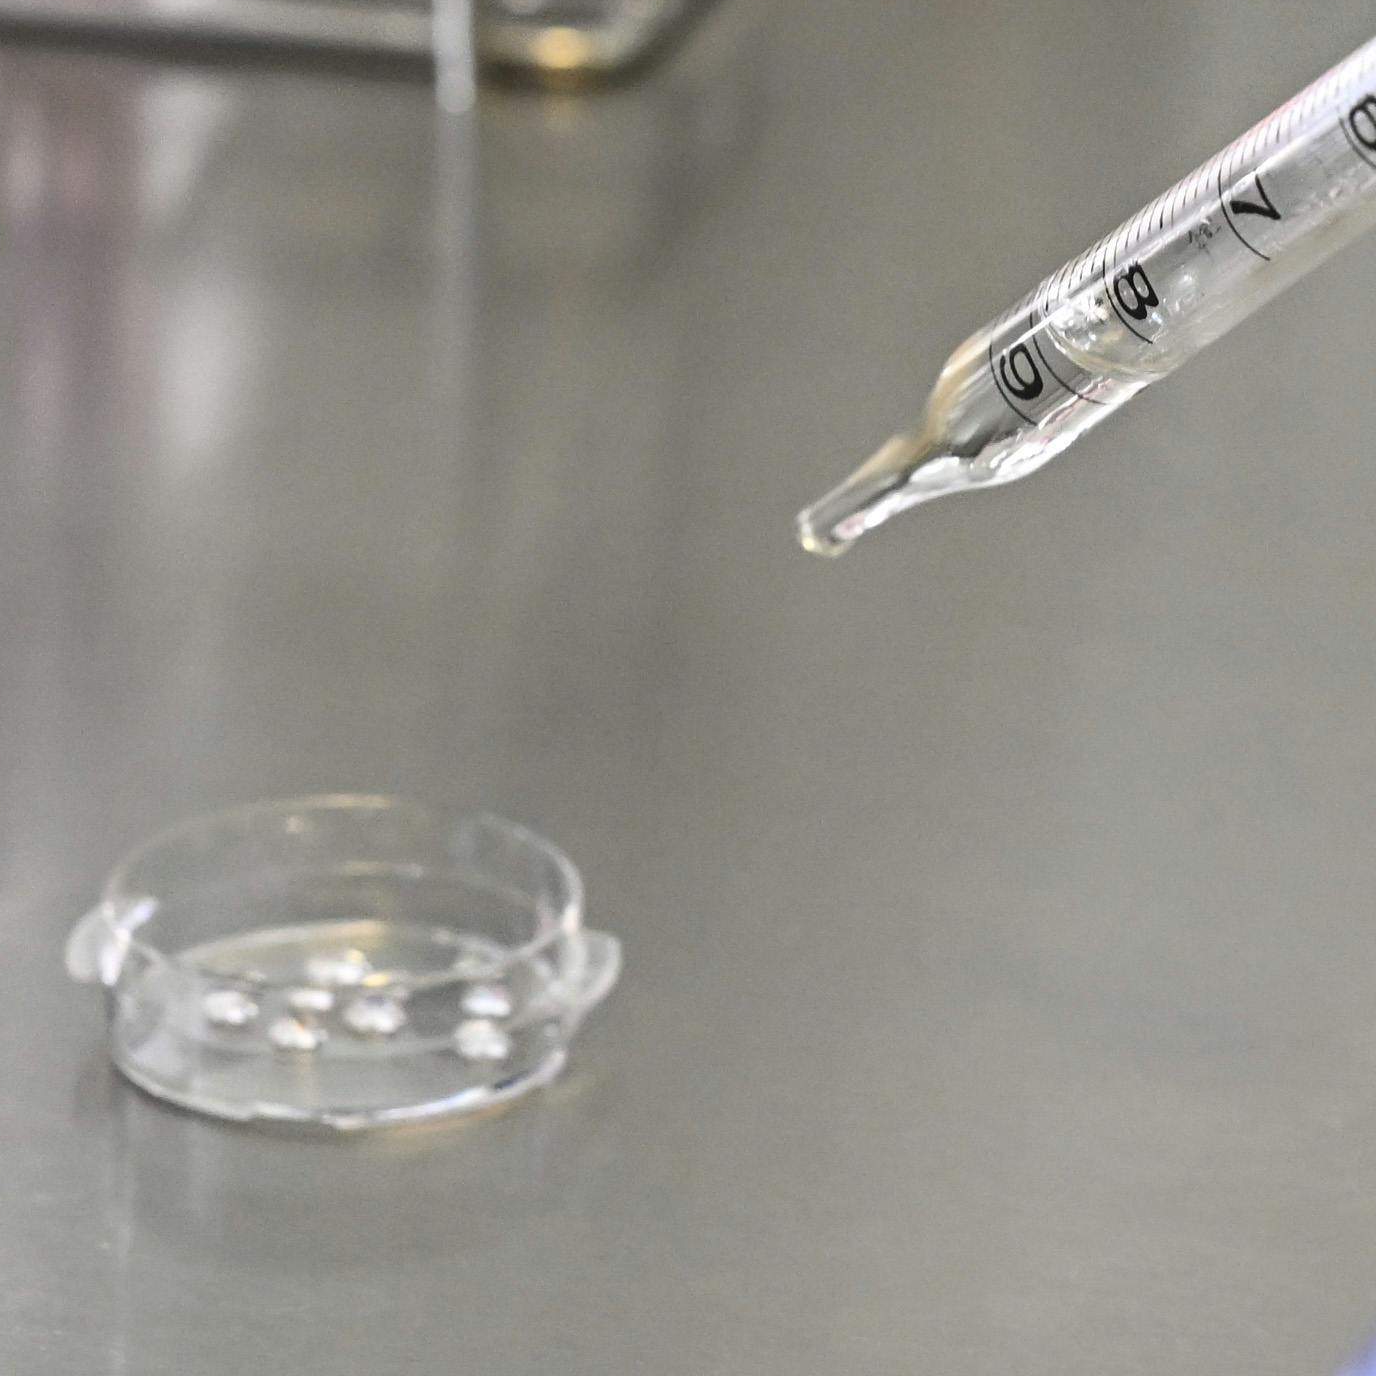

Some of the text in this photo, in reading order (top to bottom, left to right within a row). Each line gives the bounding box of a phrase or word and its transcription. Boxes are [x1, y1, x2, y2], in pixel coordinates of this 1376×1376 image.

[1228, 173, 1282, 221] 7
[1112, 260, 1160, 321] 8
[998, 342, 1044, 401] 9
